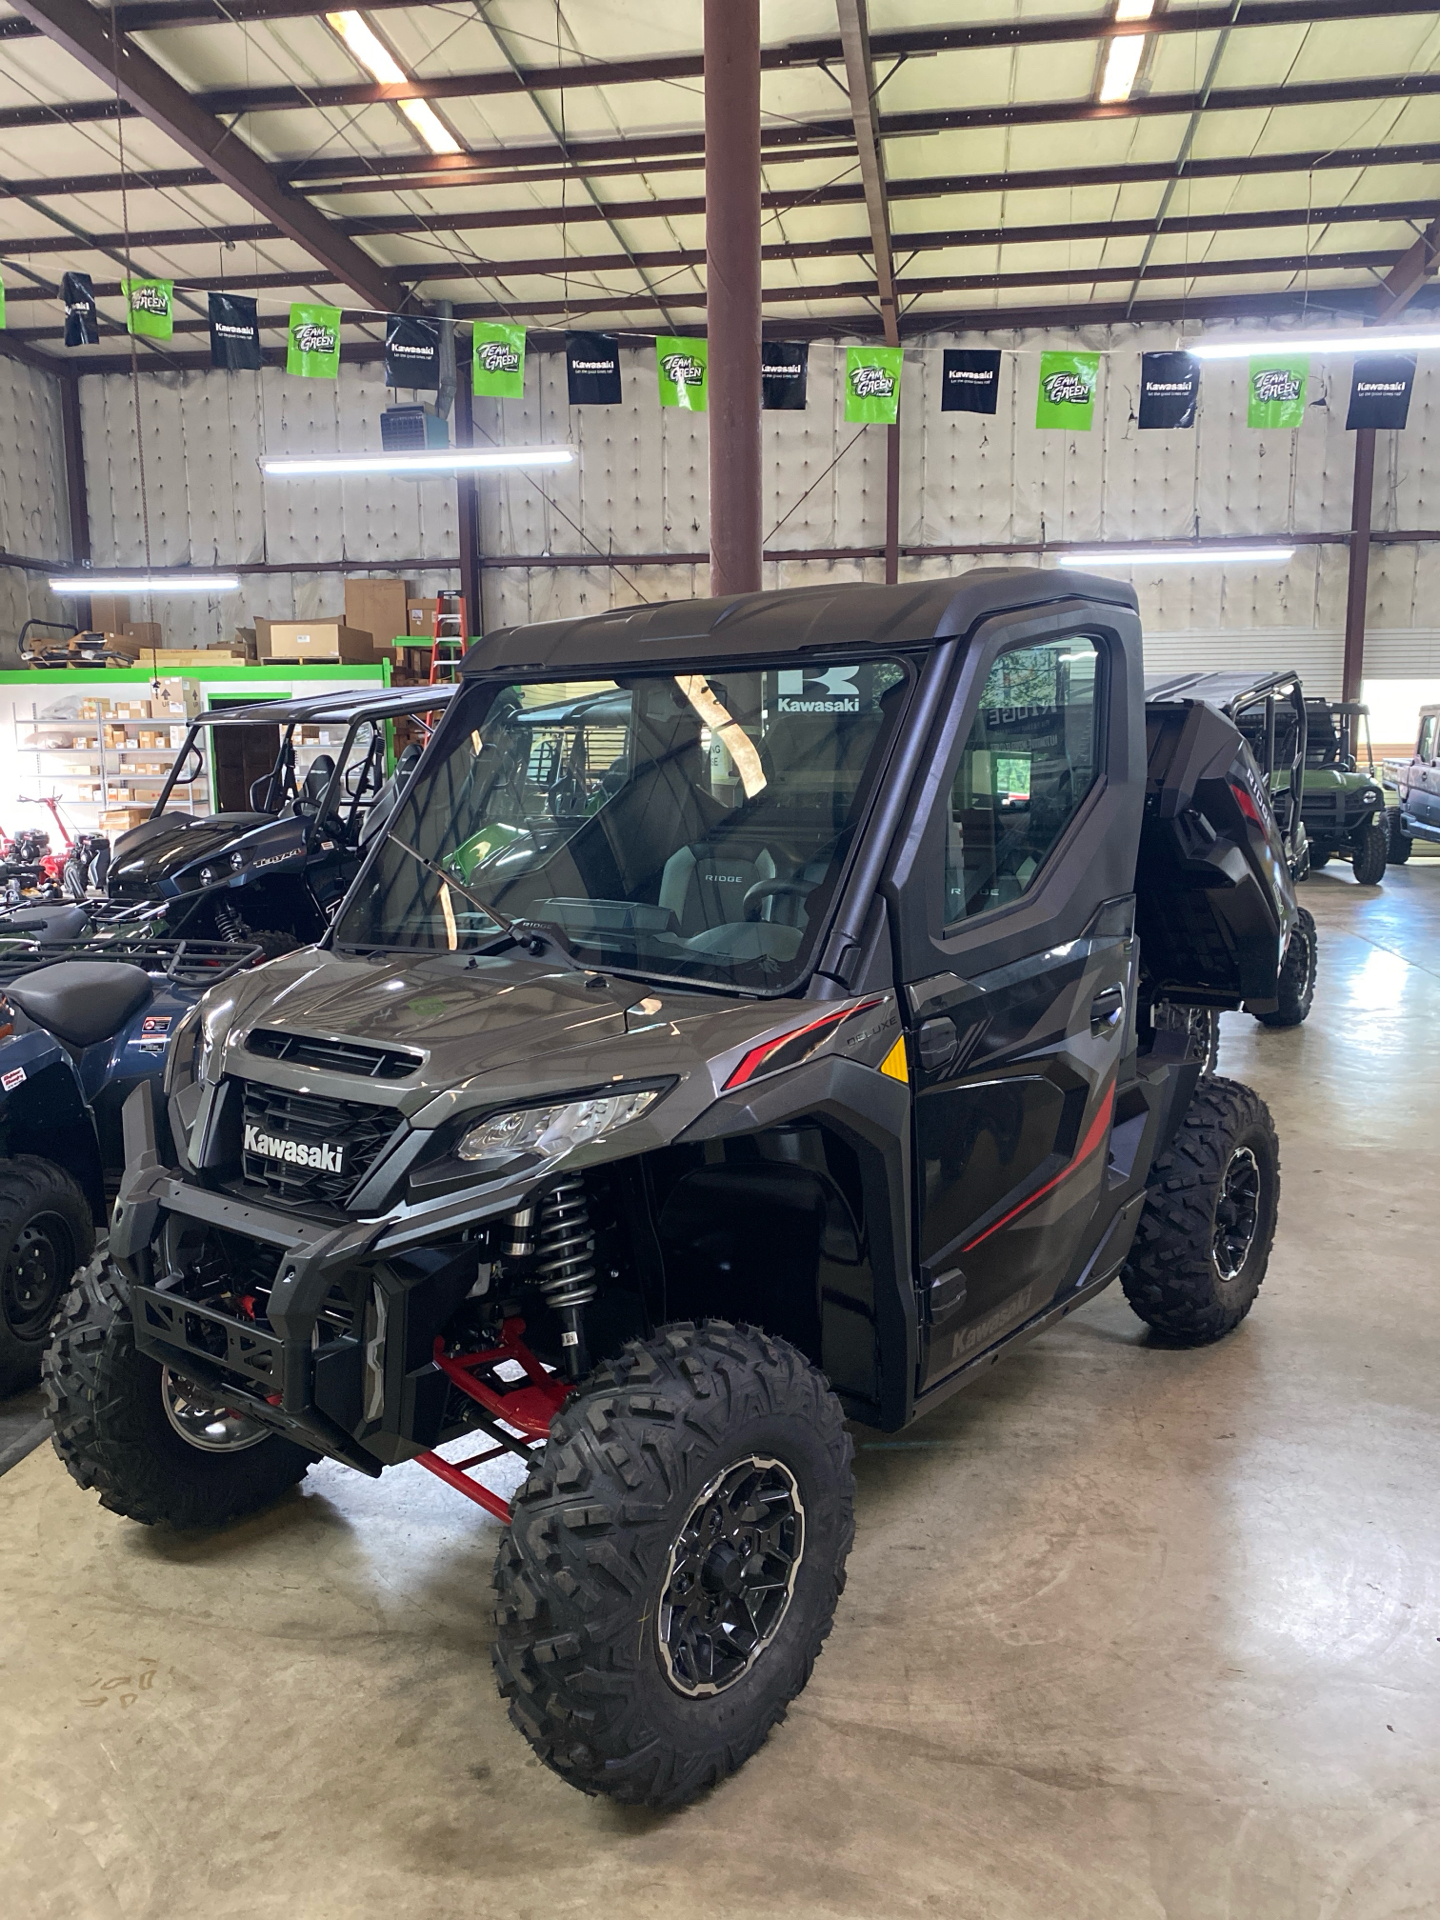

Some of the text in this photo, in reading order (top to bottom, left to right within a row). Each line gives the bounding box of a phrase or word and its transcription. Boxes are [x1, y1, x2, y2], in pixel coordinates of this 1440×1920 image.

[131, 296, 167, 310] GREEN
[215, 322, 254, 335] Kawasaki
[292, 324, 326, 339] TEAM
[300, 335, 334, 352] GREEN
[391, 343, 434, 355] Kawasaki
[476, 343, 510, 358] TEAM
[485, 355, 518, 371] GREEN
[572, 360, 614, 369] Kawasaki
[661, 355, 693, 370] TEAM
[670, 367, 702, 382] GREEN
[850, 368, 884, 384] TEAM
[949, 370, 993, 379] Kawasaki
[1043, 373, 1080, 390] TEAM
[1254, 371, 1289, 388] TEAM
[857, 378, 893, 396] GREEN
[1051, 384, 1089, 402] GREEN
[1146, 381, 1192, 391] Kawasaki
[1260, 380, 1300, 401] GREEN
[1358, 382, 1406, 391] Kawasaki
[777, 698, 859, 712] Kawasaki
[705, 874, 743, 883] RIDGE
[951, 888, 1000, 896] RGE
[522, 921, 553, 930] RIDGE
[846, 1016, 898, 1047] DELUXE
[243, 1124, 344, 1173] Kawasaki
[952, 1287, 1032, 1358] Kawasaki
